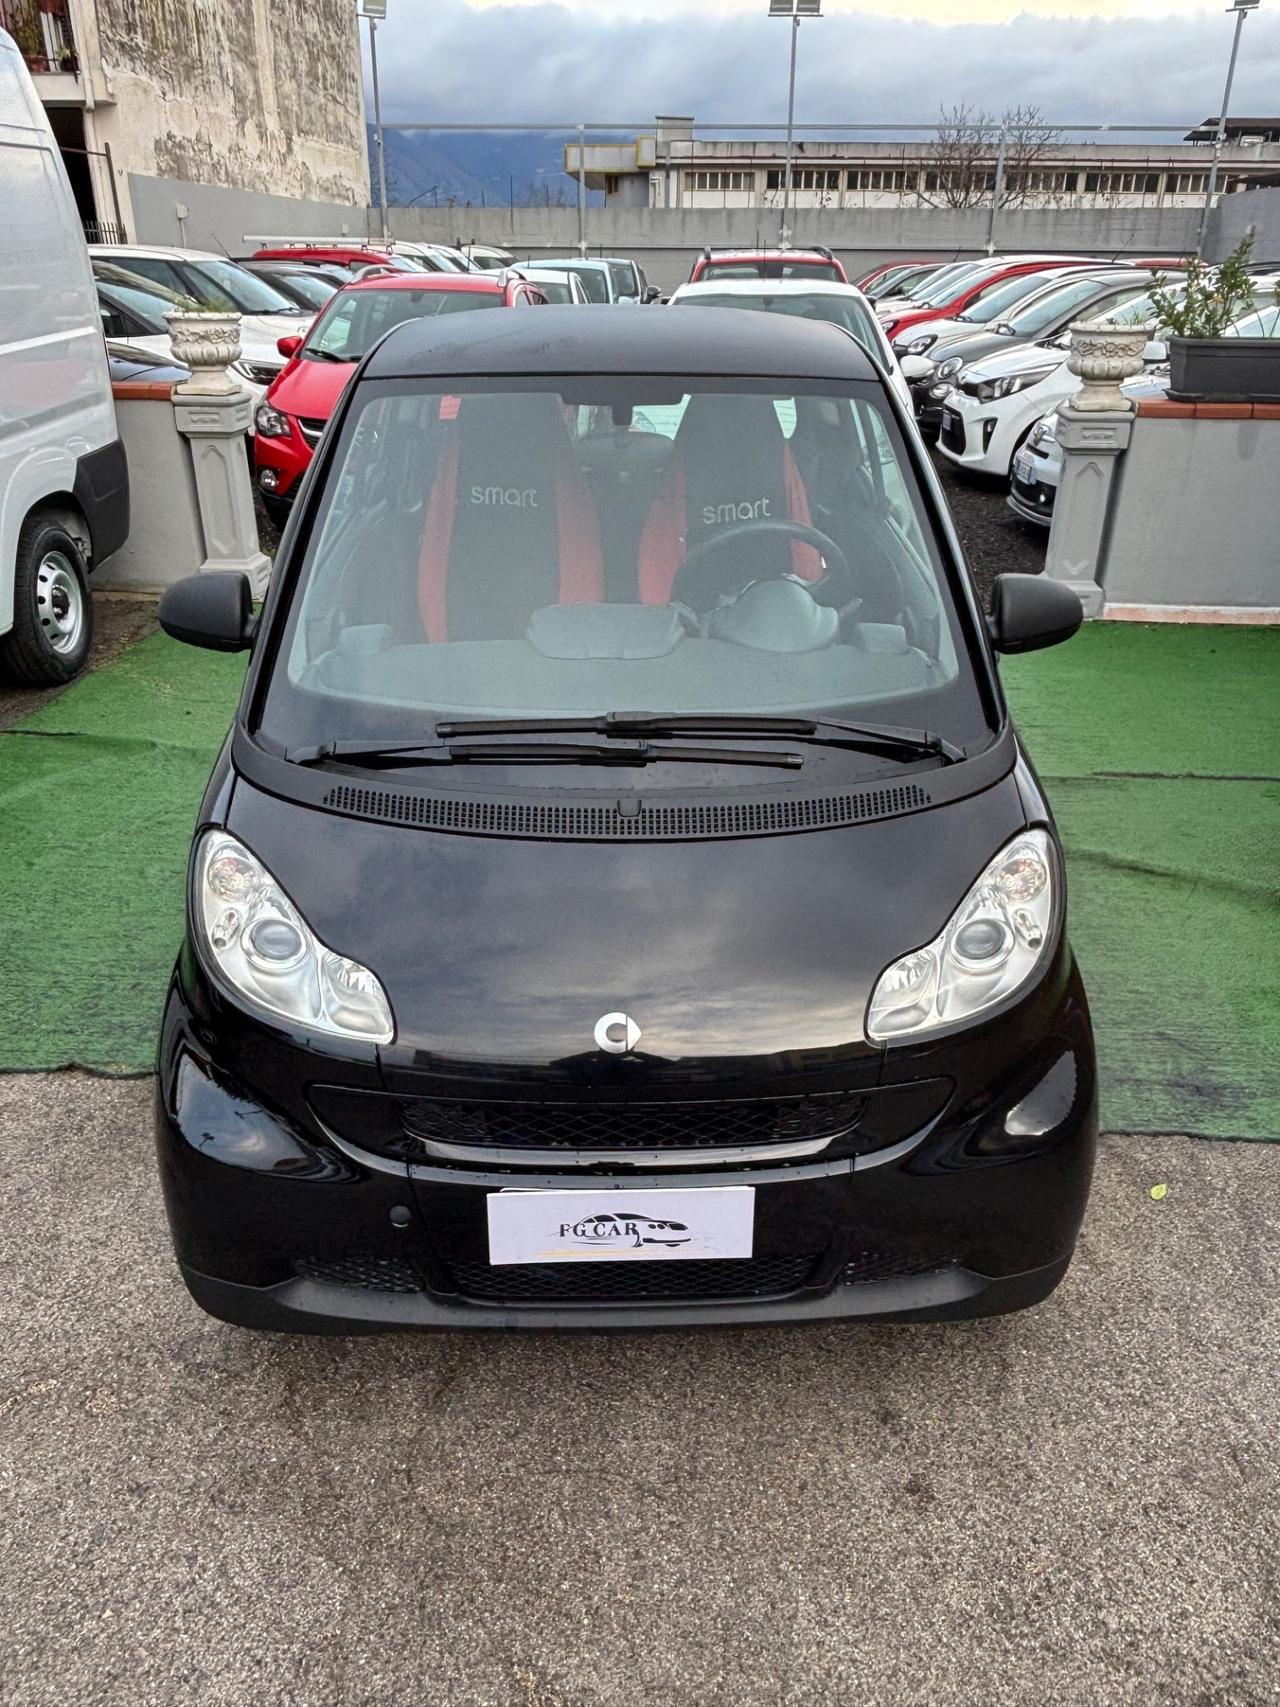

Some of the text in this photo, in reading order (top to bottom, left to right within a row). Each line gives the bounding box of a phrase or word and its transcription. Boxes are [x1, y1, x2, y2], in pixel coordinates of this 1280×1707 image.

[471, 486, 538, 508] smart
[703, 497, 771, 524] smart
[559, 1222, 639, 1237] FG CAR
